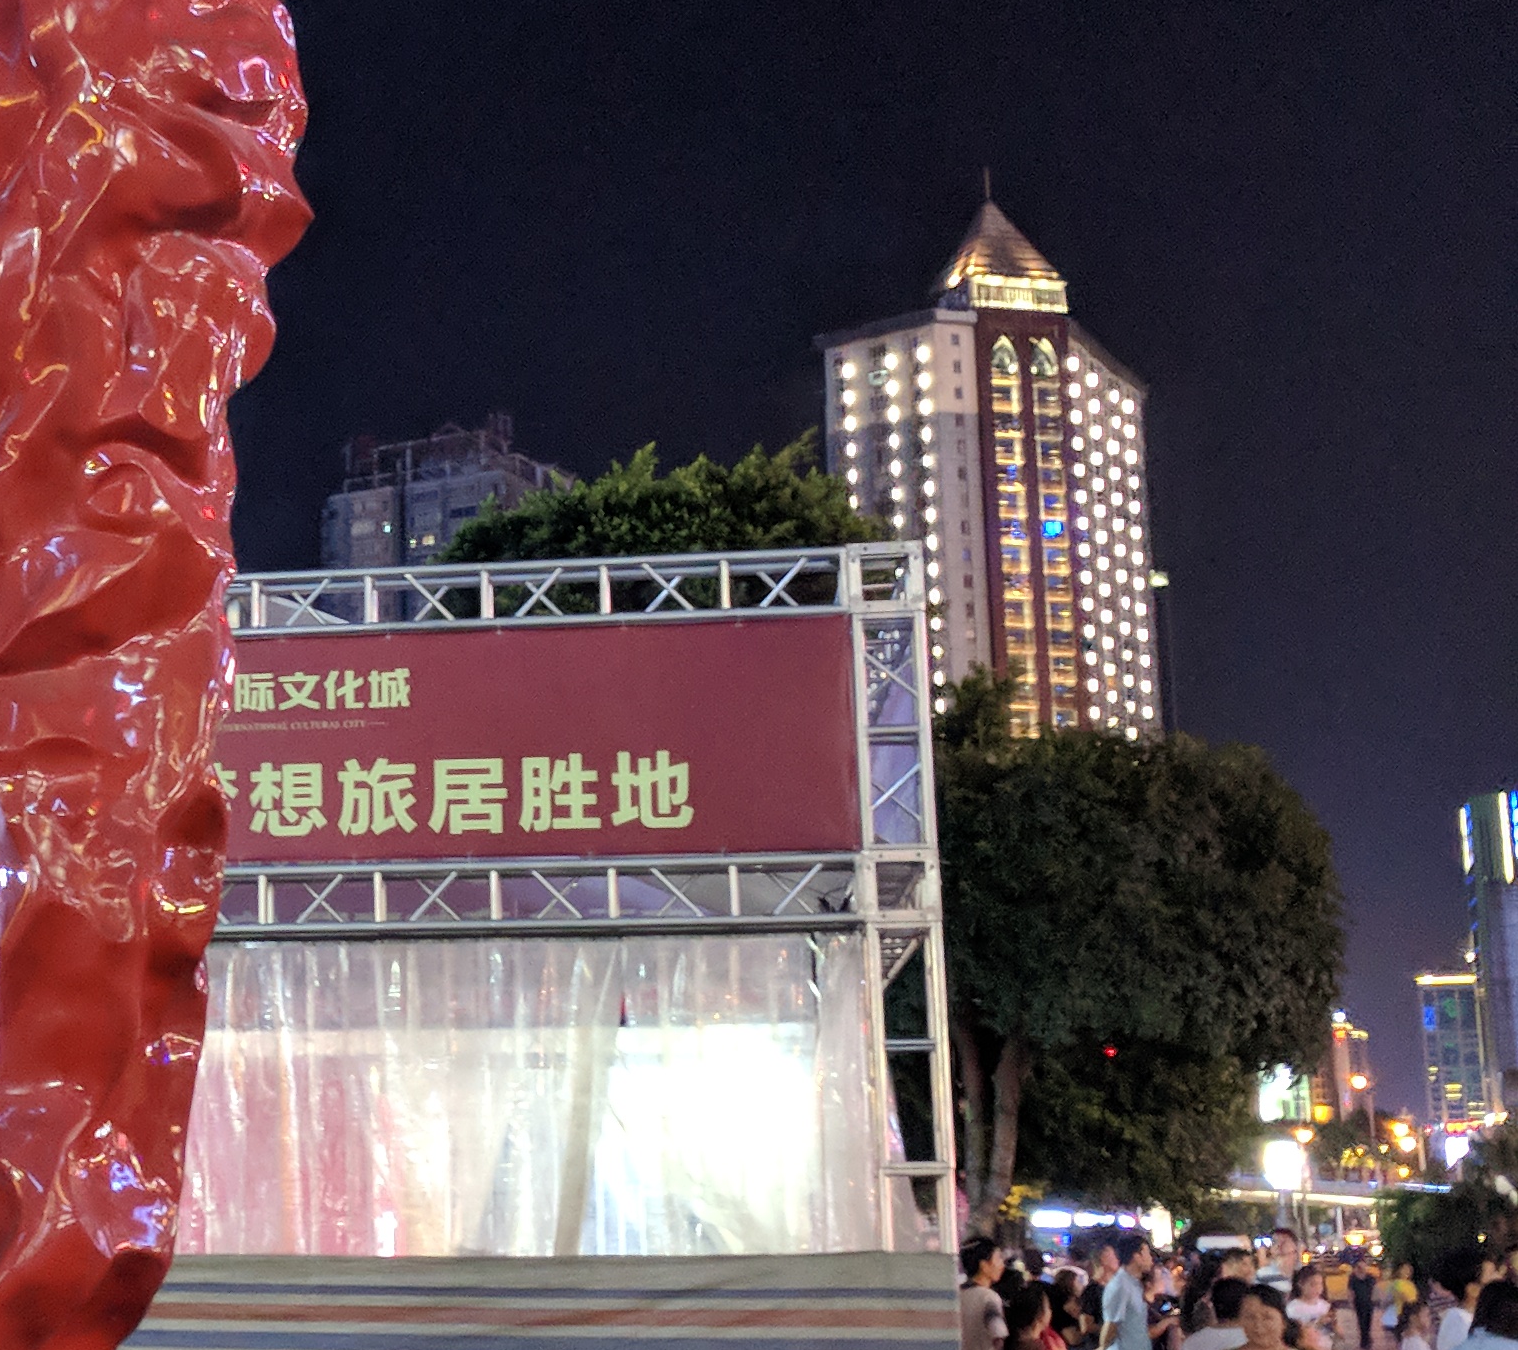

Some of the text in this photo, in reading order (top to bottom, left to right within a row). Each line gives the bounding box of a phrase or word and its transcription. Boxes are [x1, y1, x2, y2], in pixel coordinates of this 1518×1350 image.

[234, 668, 411, 713] 际文化城
[213, 750, 694, 837] 想旅居胜地
